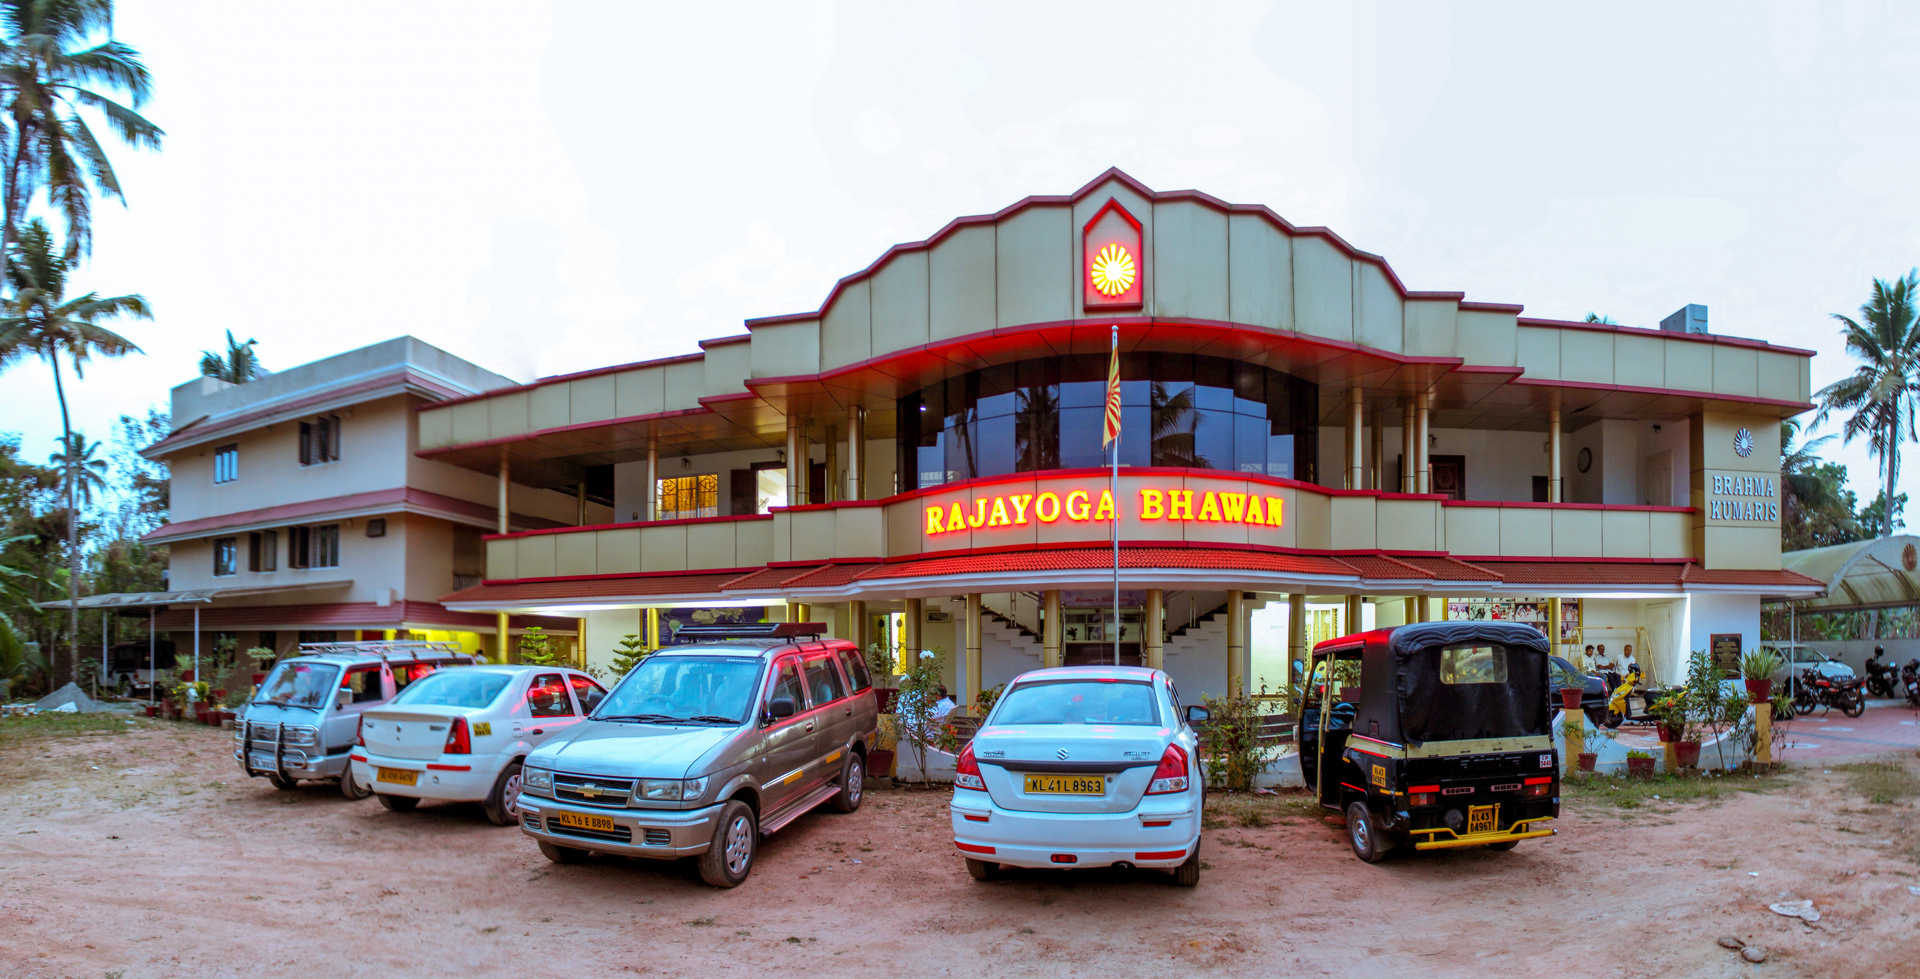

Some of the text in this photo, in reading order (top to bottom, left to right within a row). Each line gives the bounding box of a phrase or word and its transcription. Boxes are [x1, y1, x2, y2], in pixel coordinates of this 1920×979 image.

[1713, 475, 1774, 497] BRAHMA
[926, 489, 1283, 534] RAJAYOGA BHAWAN
[1711, 500, 1777, 521] KUMARIS
